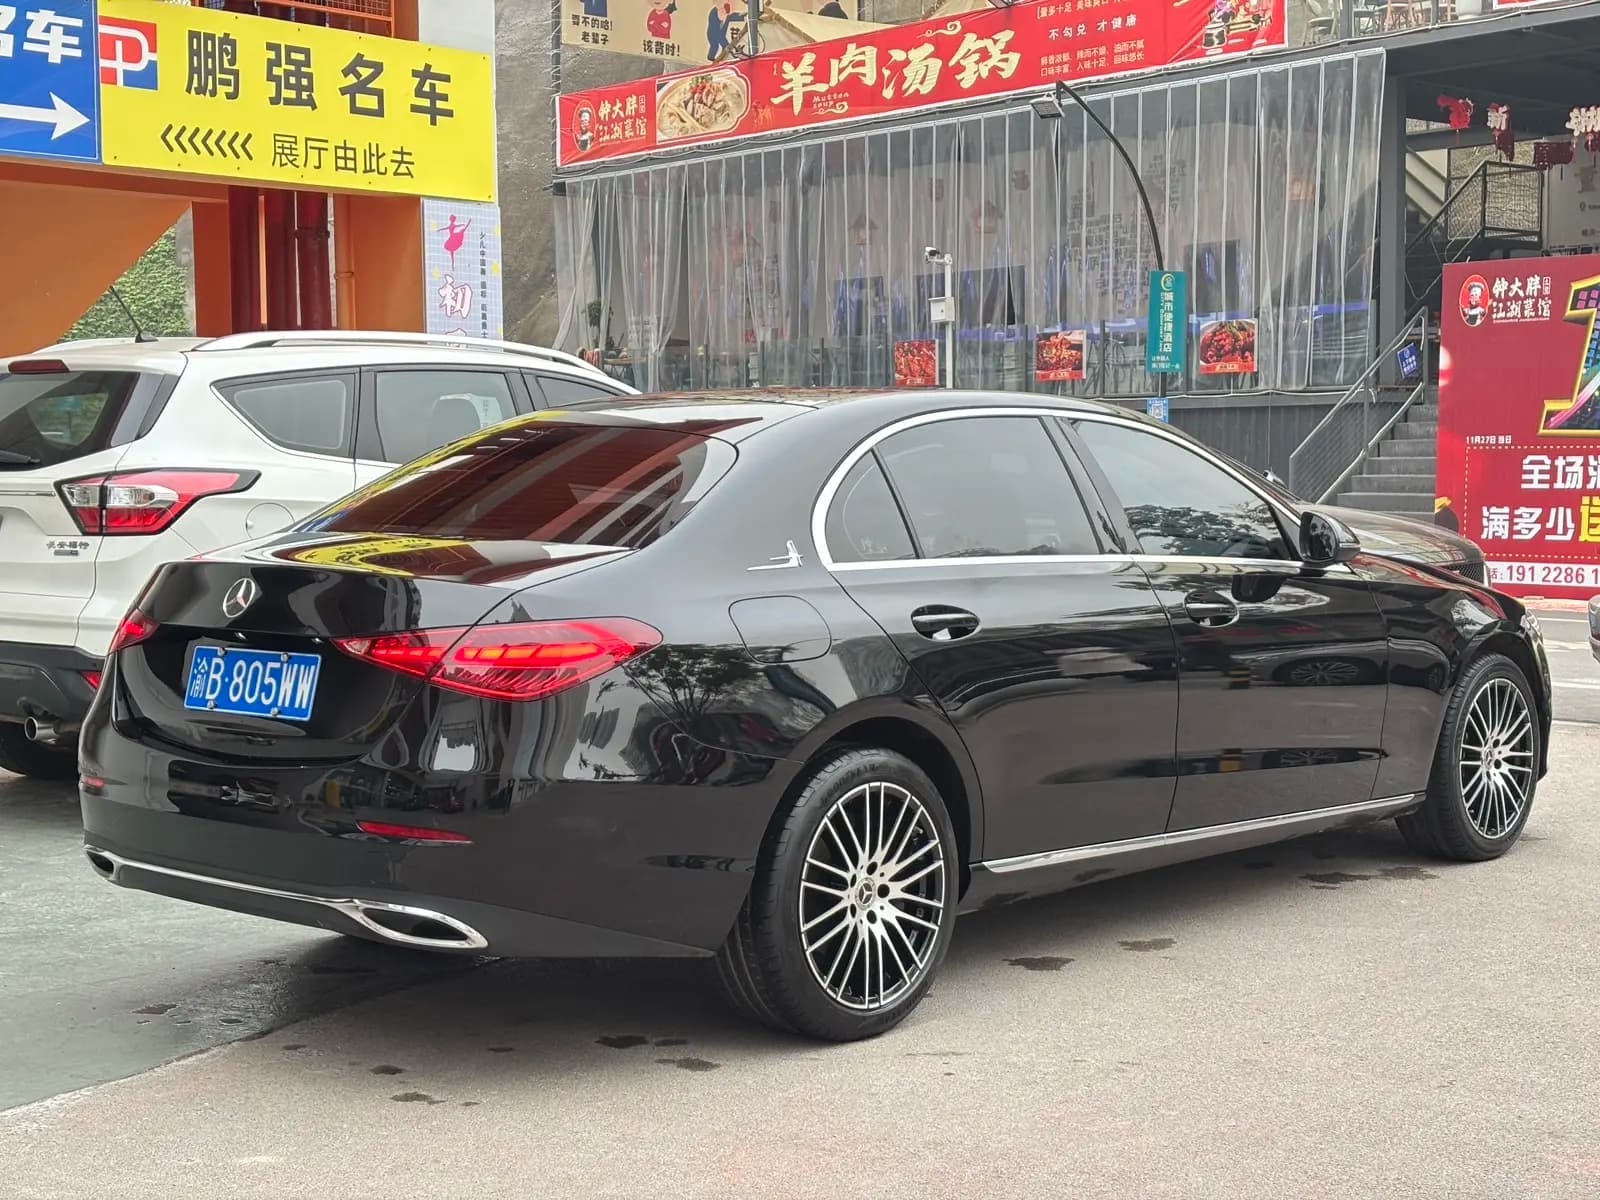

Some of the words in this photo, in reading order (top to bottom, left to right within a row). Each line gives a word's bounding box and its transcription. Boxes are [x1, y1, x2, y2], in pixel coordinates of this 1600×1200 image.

[0, 4, 84, 64] 车
[581, 31, 609, 45] 老辈子
[185, 29, 454, 127] 鹏强名车
[769, 28, 1022, 117] 羊肉汤锅
[271, 133, 416, 179] 展厅由此去
[1491, 297, 1552, 319] 江湖菜馆
[1466, 435, 1496, 444] 11月27日
[1506, 564, 1536, 583] 191
[1541, 565, 1585, 584] 2286
